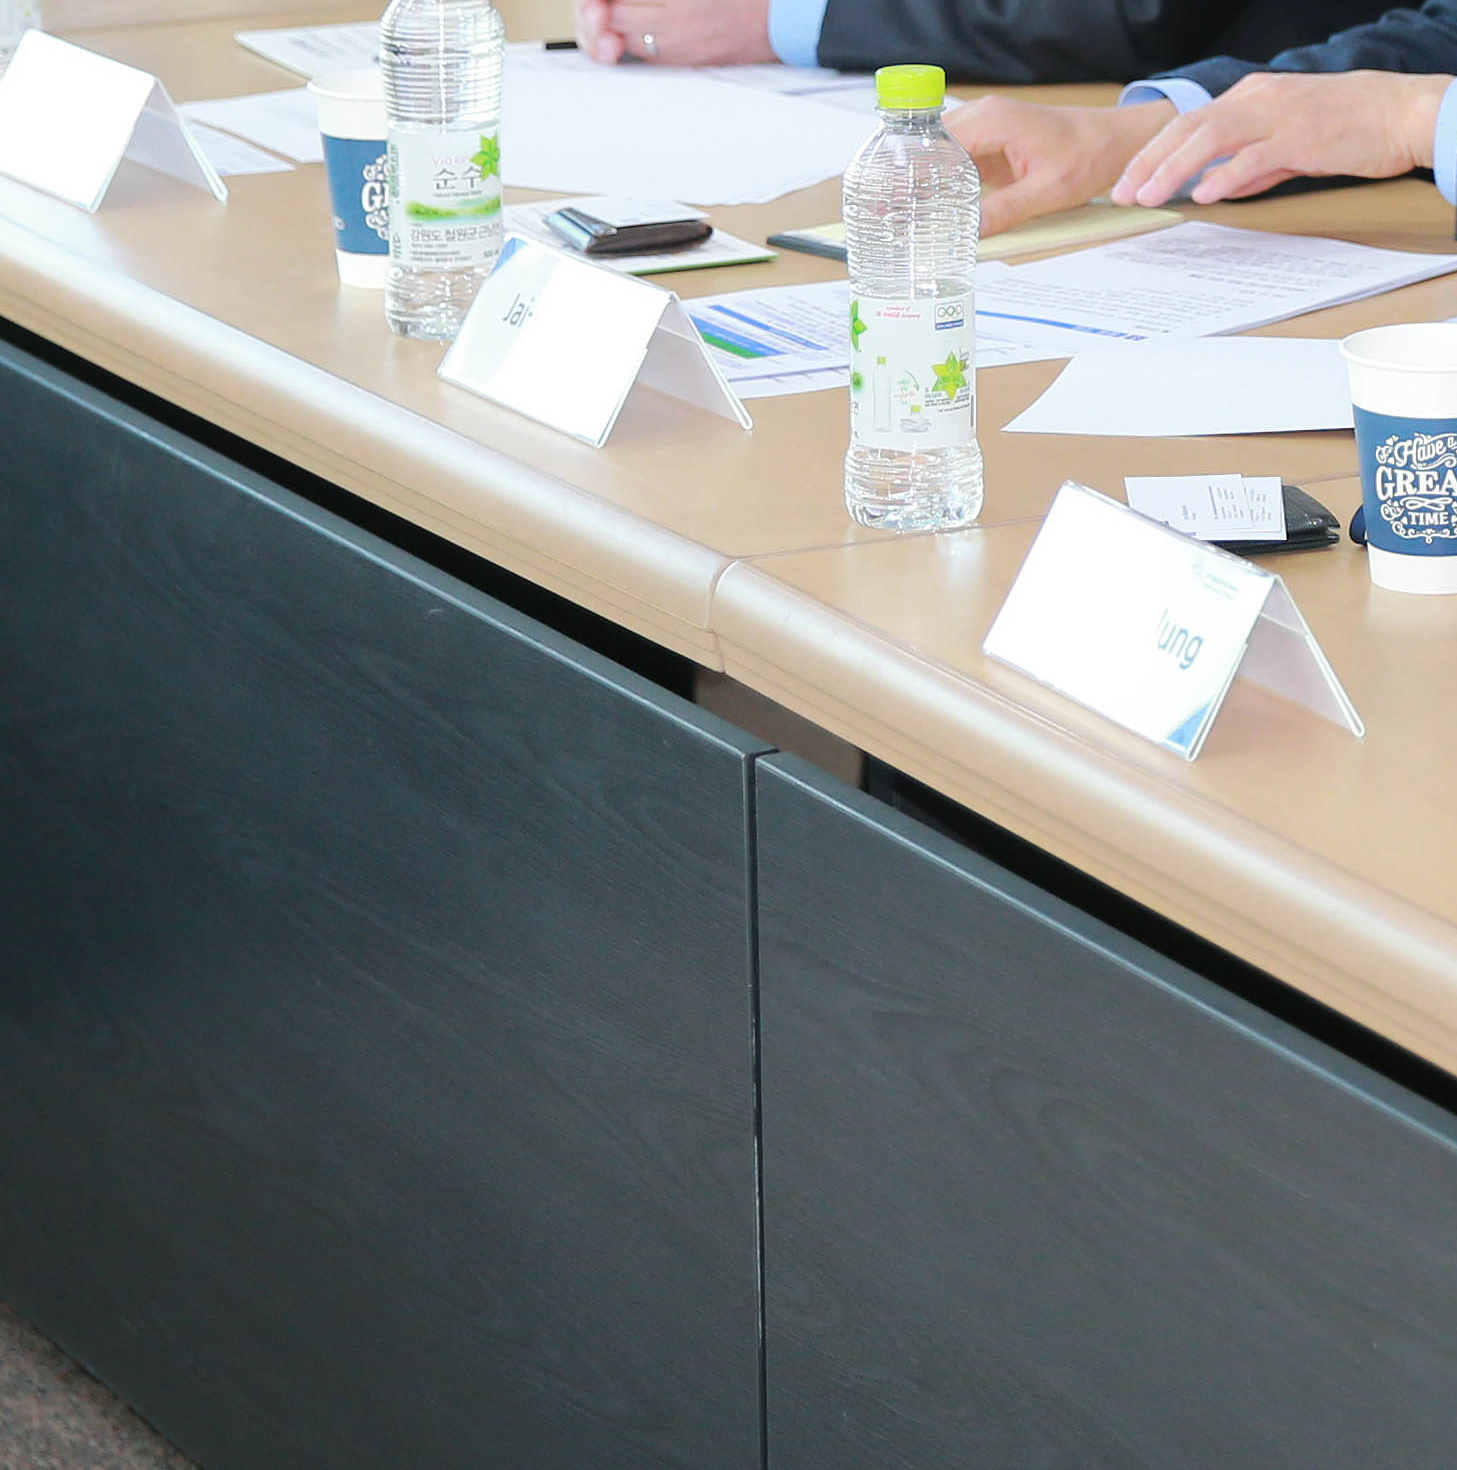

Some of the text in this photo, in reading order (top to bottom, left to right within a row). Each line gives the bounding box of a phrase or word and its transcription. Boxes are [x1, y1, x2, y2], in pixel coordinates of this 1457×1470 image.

[433, 166, 483, 190] 순수
[1394, 434, 1457, 468] Have a
[1408, 511, 1449, 526] TIME
